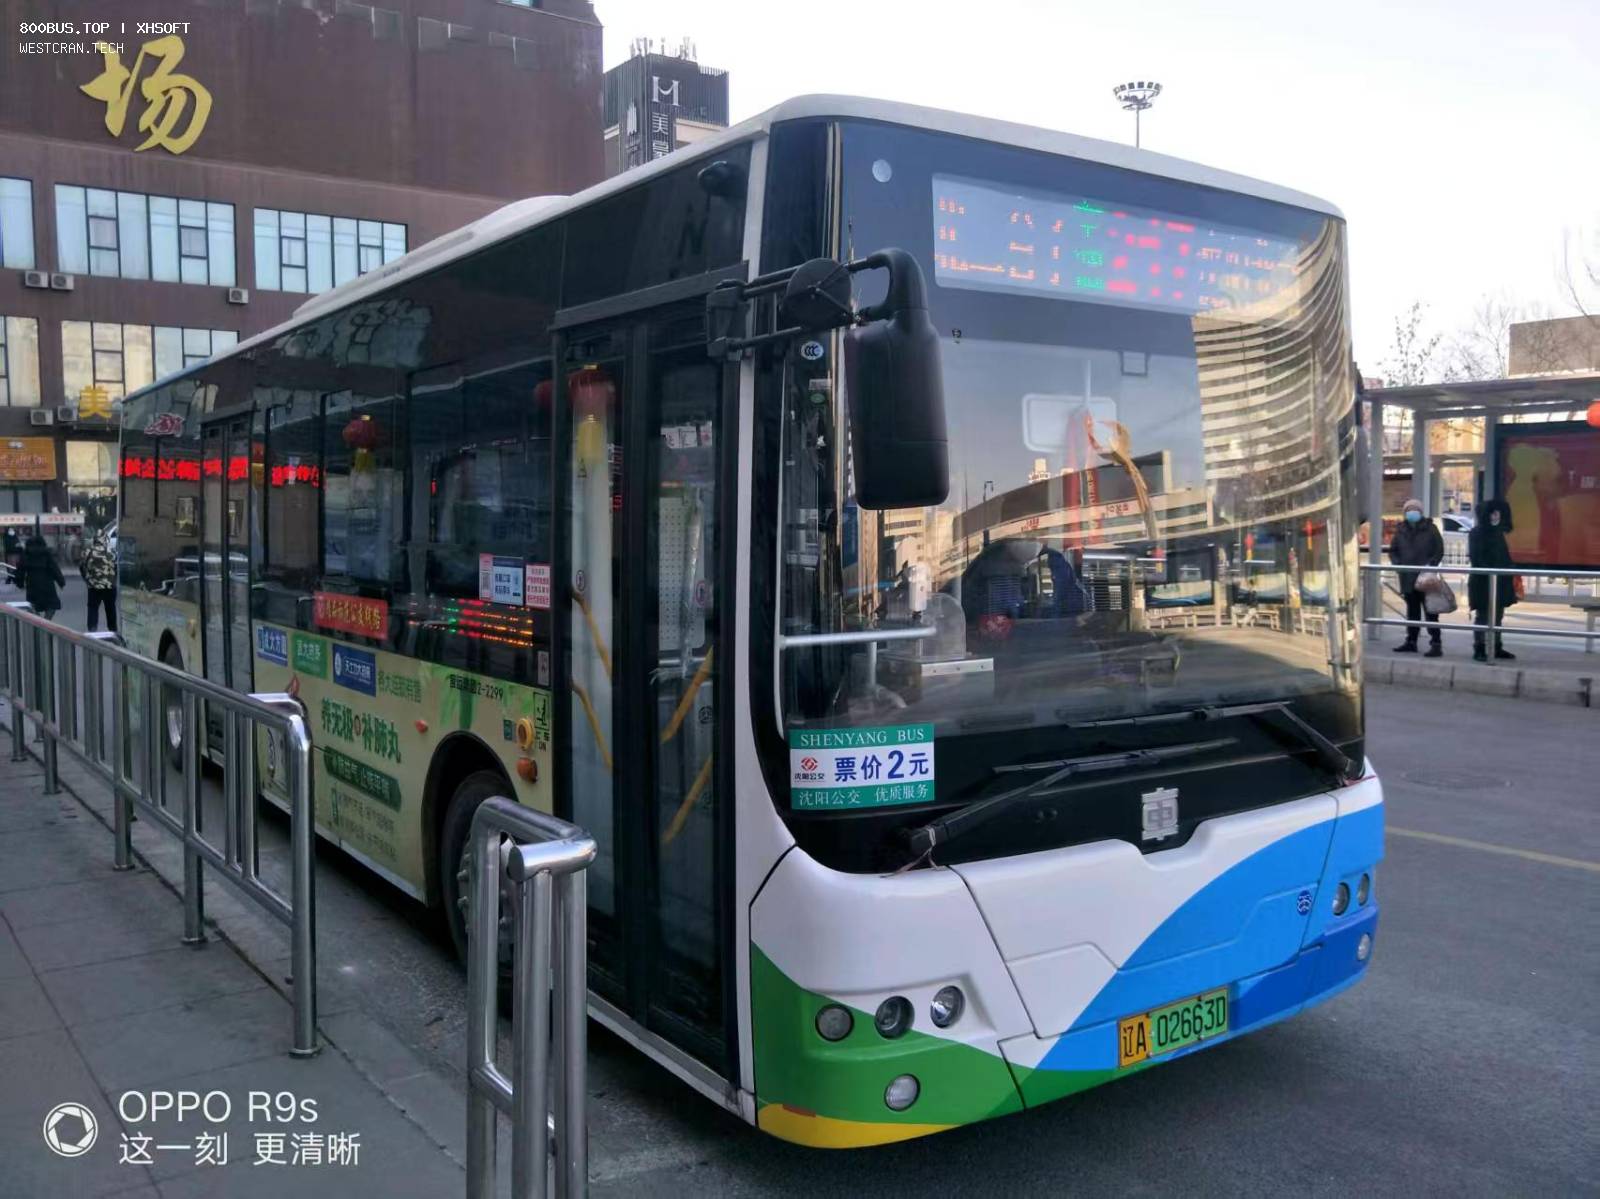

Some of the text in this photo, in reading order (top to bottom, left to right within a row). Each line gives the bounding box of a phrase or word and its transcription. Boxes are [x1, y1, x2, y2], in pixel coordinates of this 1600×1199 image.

[80, 35, 213, 154] 场
[800, 728, 924, 747] SHENYANG BUS
[834, 749, 929, 783] 票价2元
[799, 784, 928, 806] 沈阳公交 优质服务
[1156, 995, 1226, 1047] 02663D
